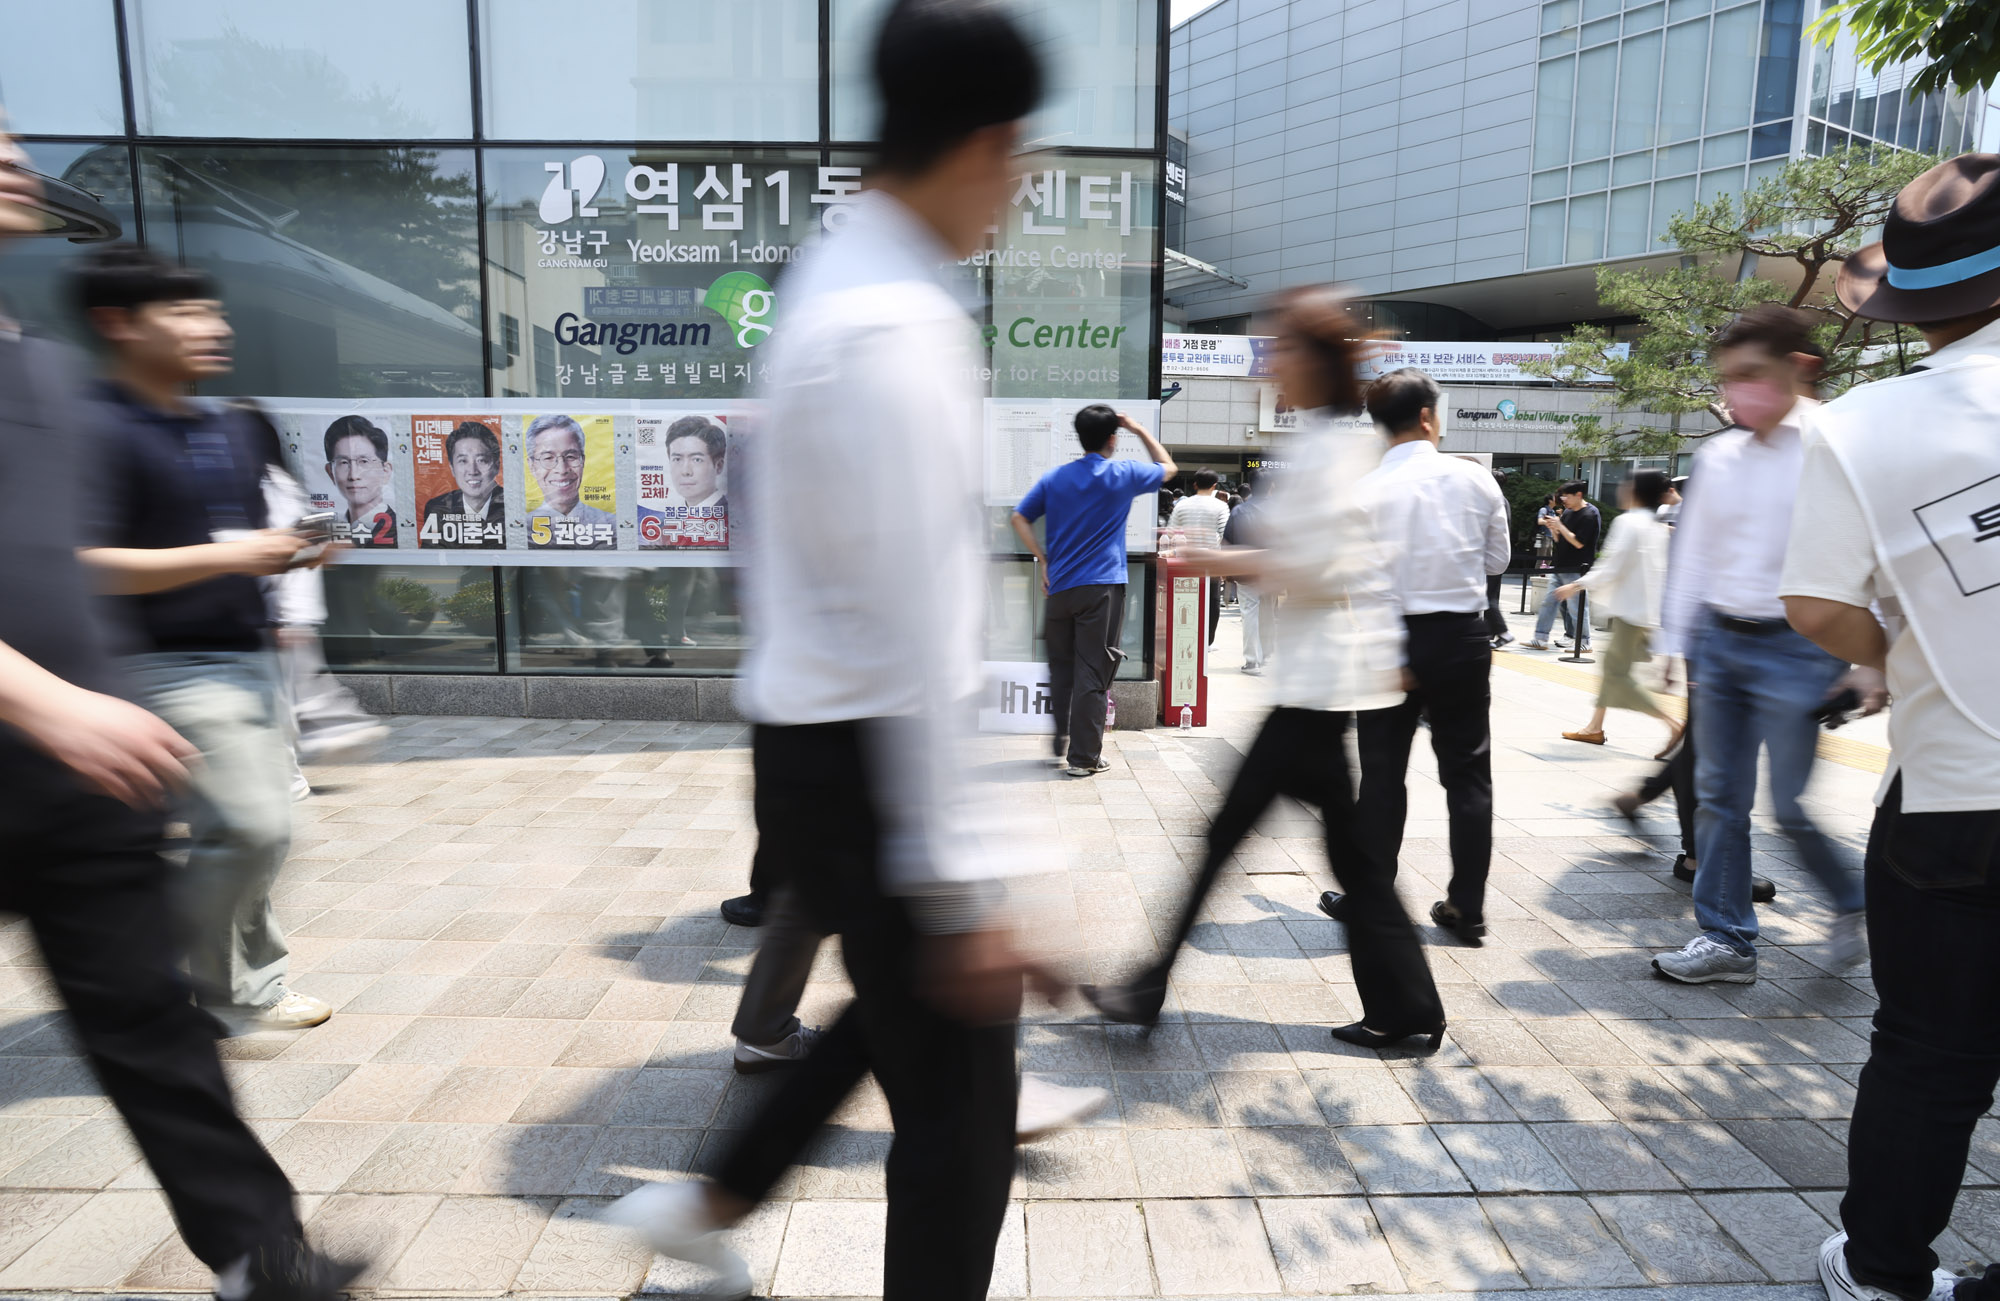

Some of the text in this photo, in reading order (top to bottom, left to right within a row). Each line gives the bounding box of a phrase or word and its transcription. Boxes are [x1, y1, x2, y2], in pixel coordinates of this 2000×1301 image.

[984, 170, 1132, 236] 센터
[536, 230, 610, 255] 강남구
[627, 240, 720, 262] Yeoksam
[1050, 246, 1127, 269] Center
[554, 313, 711, 355] Gangnam
[1008, 317, 1127, 349] Center
[1161, 339, 1181, 349] 배출
[1213, 355, 1245, 365] 드립니다
[1420, 353, 1430, 364] 짐
[1433, 353, 1455, 364] 보관
[1456, 354, 1487, 365] 서비스
[1010, 364, 1038, 382] for
[1047, 365, 1120, 384] Expats
[1457, 408, 1498, 421] Gangnam
[1538, 413, 1570, 424] Village
[416, 420, 454, 435] 미래를
[416, 435, 442, 449] 여는
[417, 449, 443, 464] 선택
[1247, 460, 1260, 468] 365
[640, 474, 664, 486] 정치
[641, 487, 669, 499] 교체!
[326, 512, 394, 544] 문수 2
[420, 512, 504, 544] 4 이준석
[531, 516, 614, 545] 5 권영국
[640, 515, 727, 542] 6 구주와
